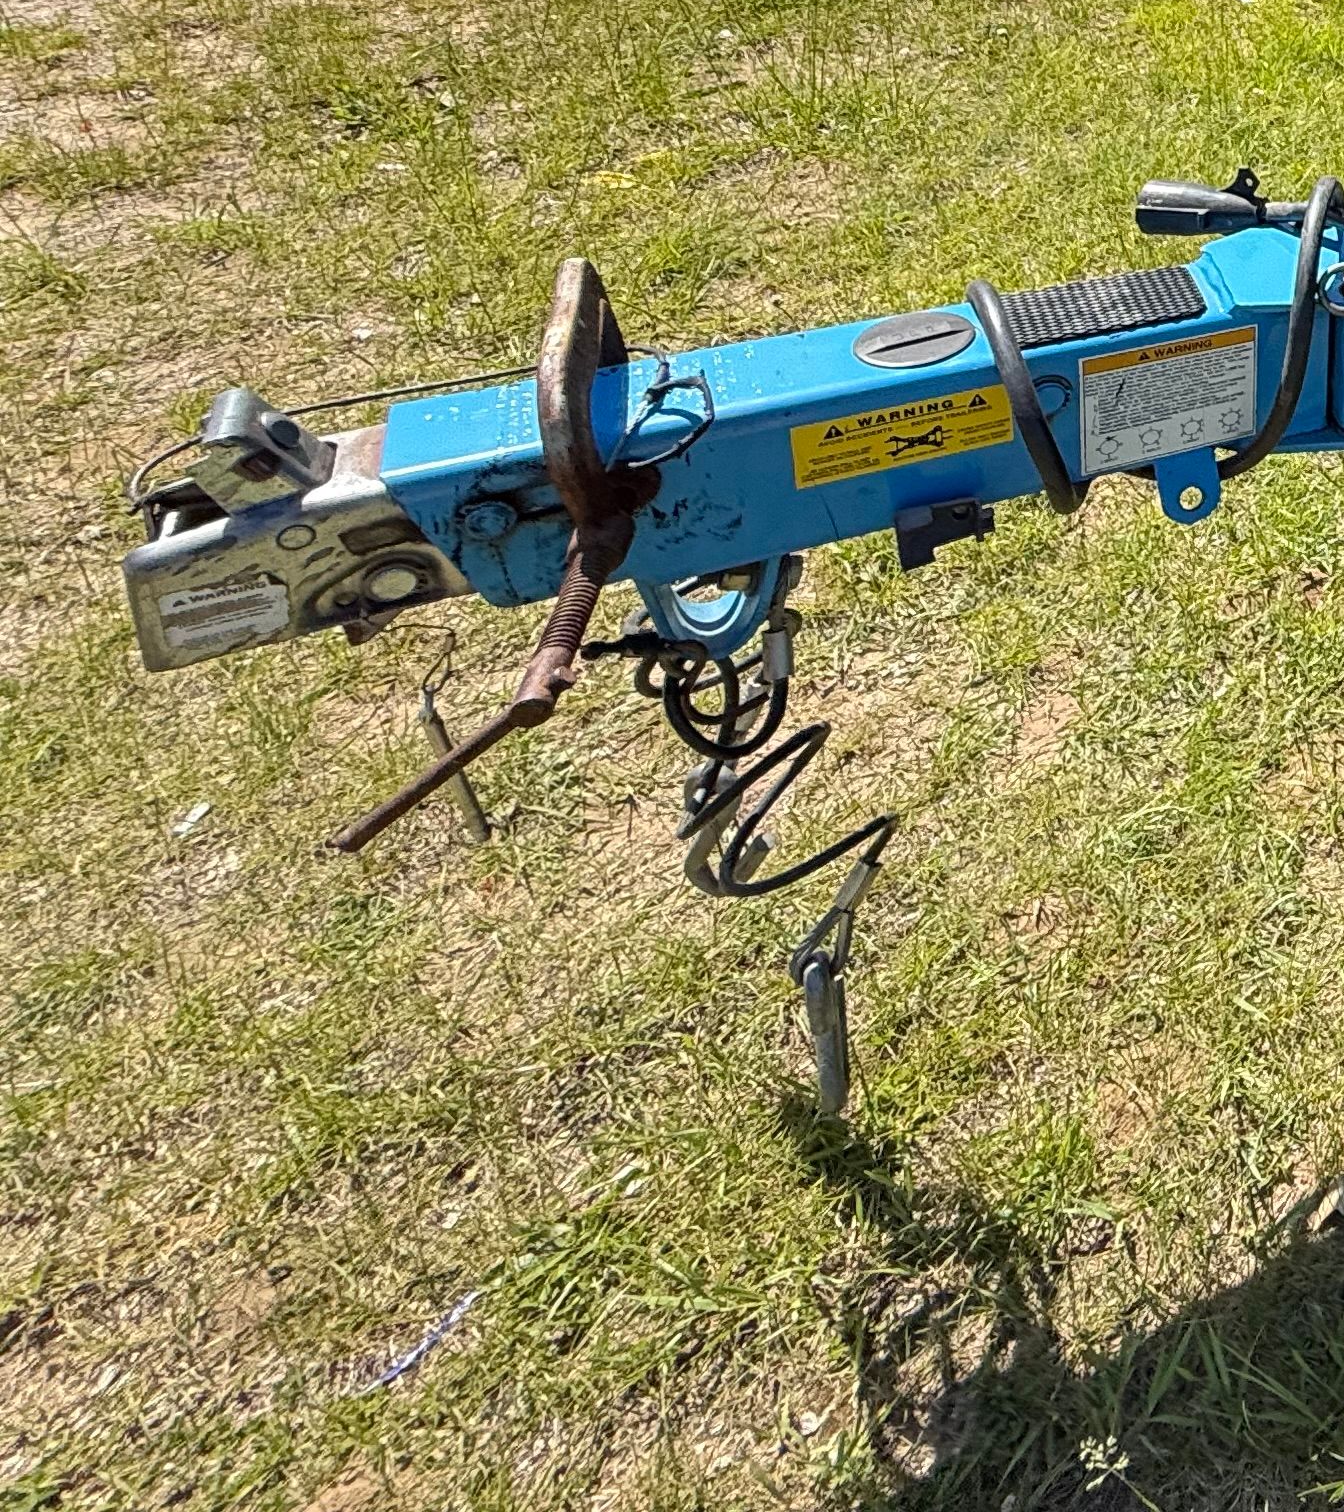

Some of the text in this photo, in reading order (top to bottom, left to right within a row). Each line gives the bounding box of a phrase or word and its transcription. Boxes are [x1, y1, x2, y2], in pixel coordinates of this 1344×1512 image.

[1154, 339, 1213, 358] WARNING
[857, 399, 954, 428] WARNING
[188, 581, 267, 603] WARNING
